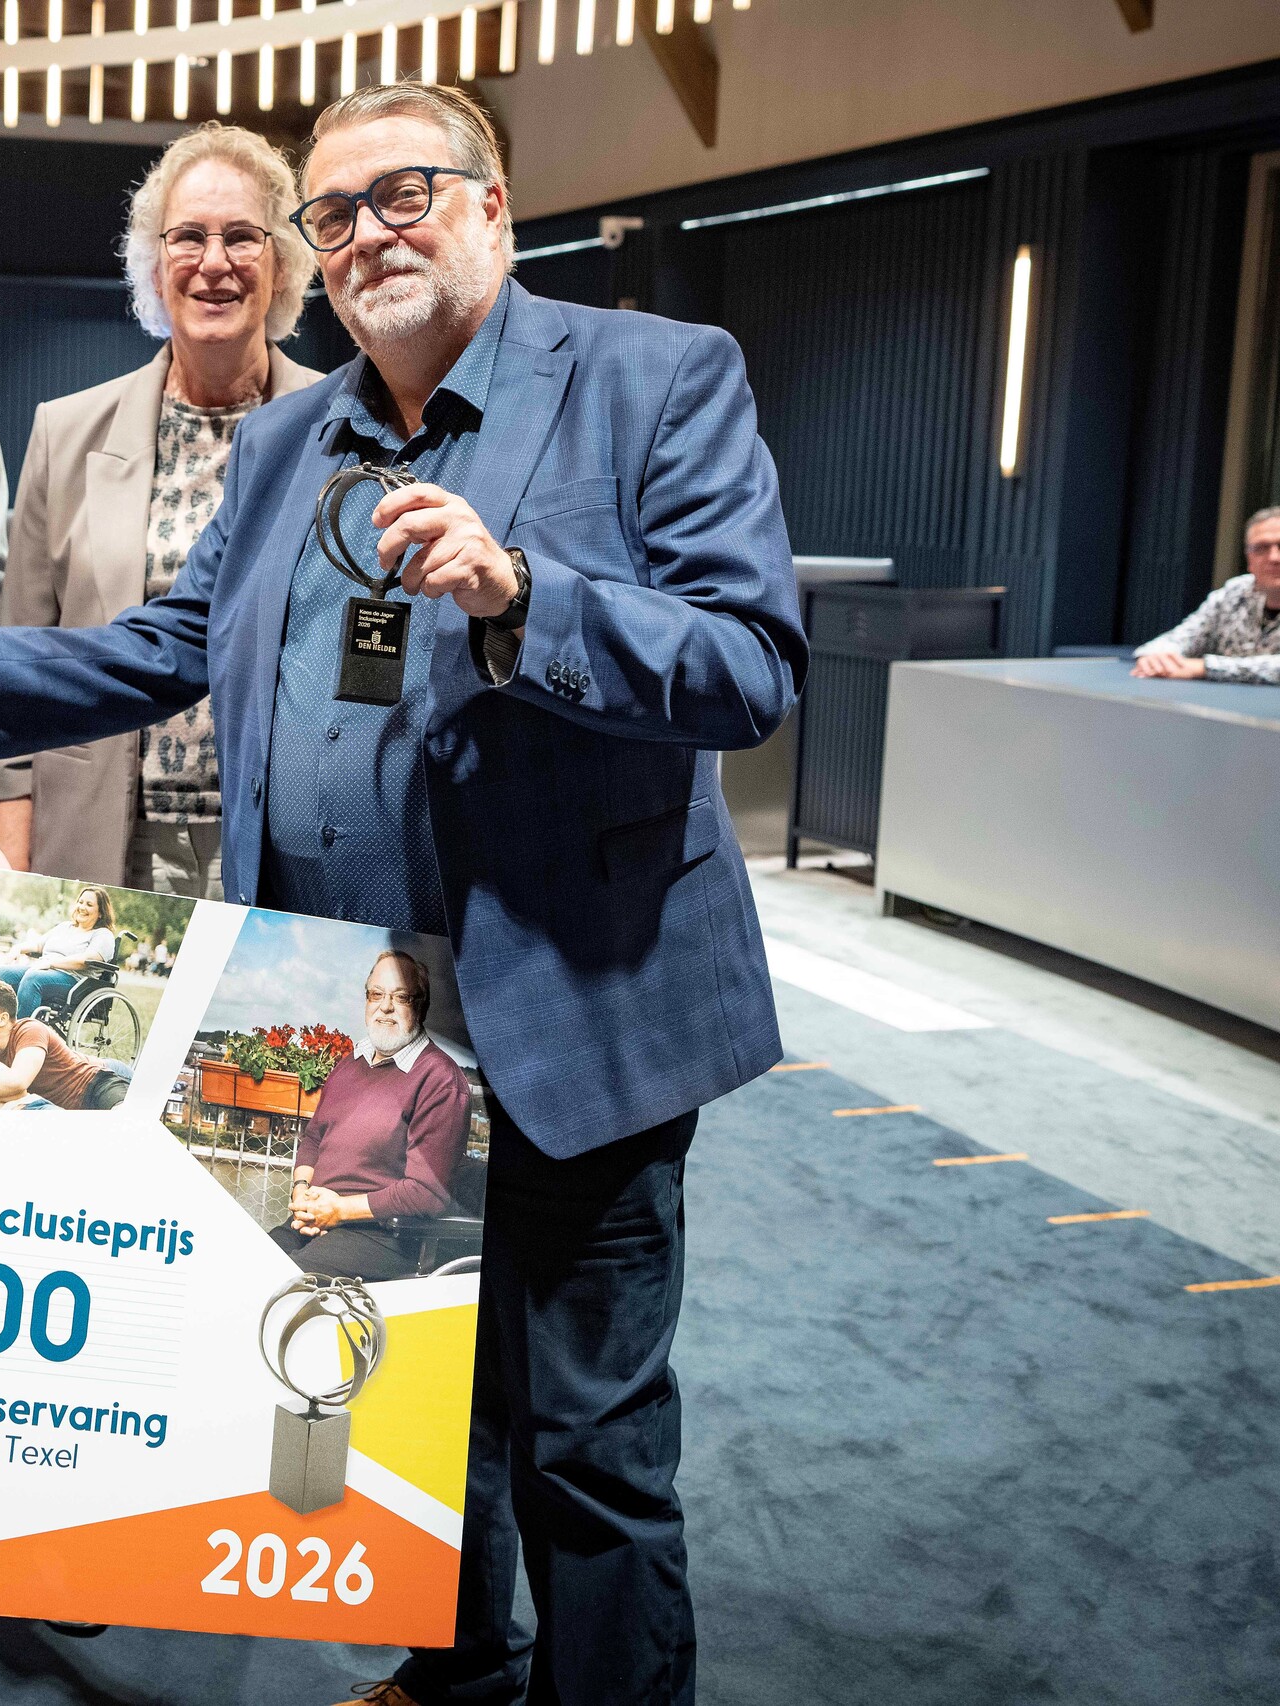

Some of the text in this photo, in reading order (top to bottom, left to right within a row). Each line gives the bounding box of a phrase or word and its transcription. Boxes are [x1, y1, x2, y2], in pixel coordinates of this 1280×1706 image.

[358, 642, 397, 653] DEN HELDER
[6, 1435, 78, 1468] Texel
[200, 1528, 374, 1606] 2026
